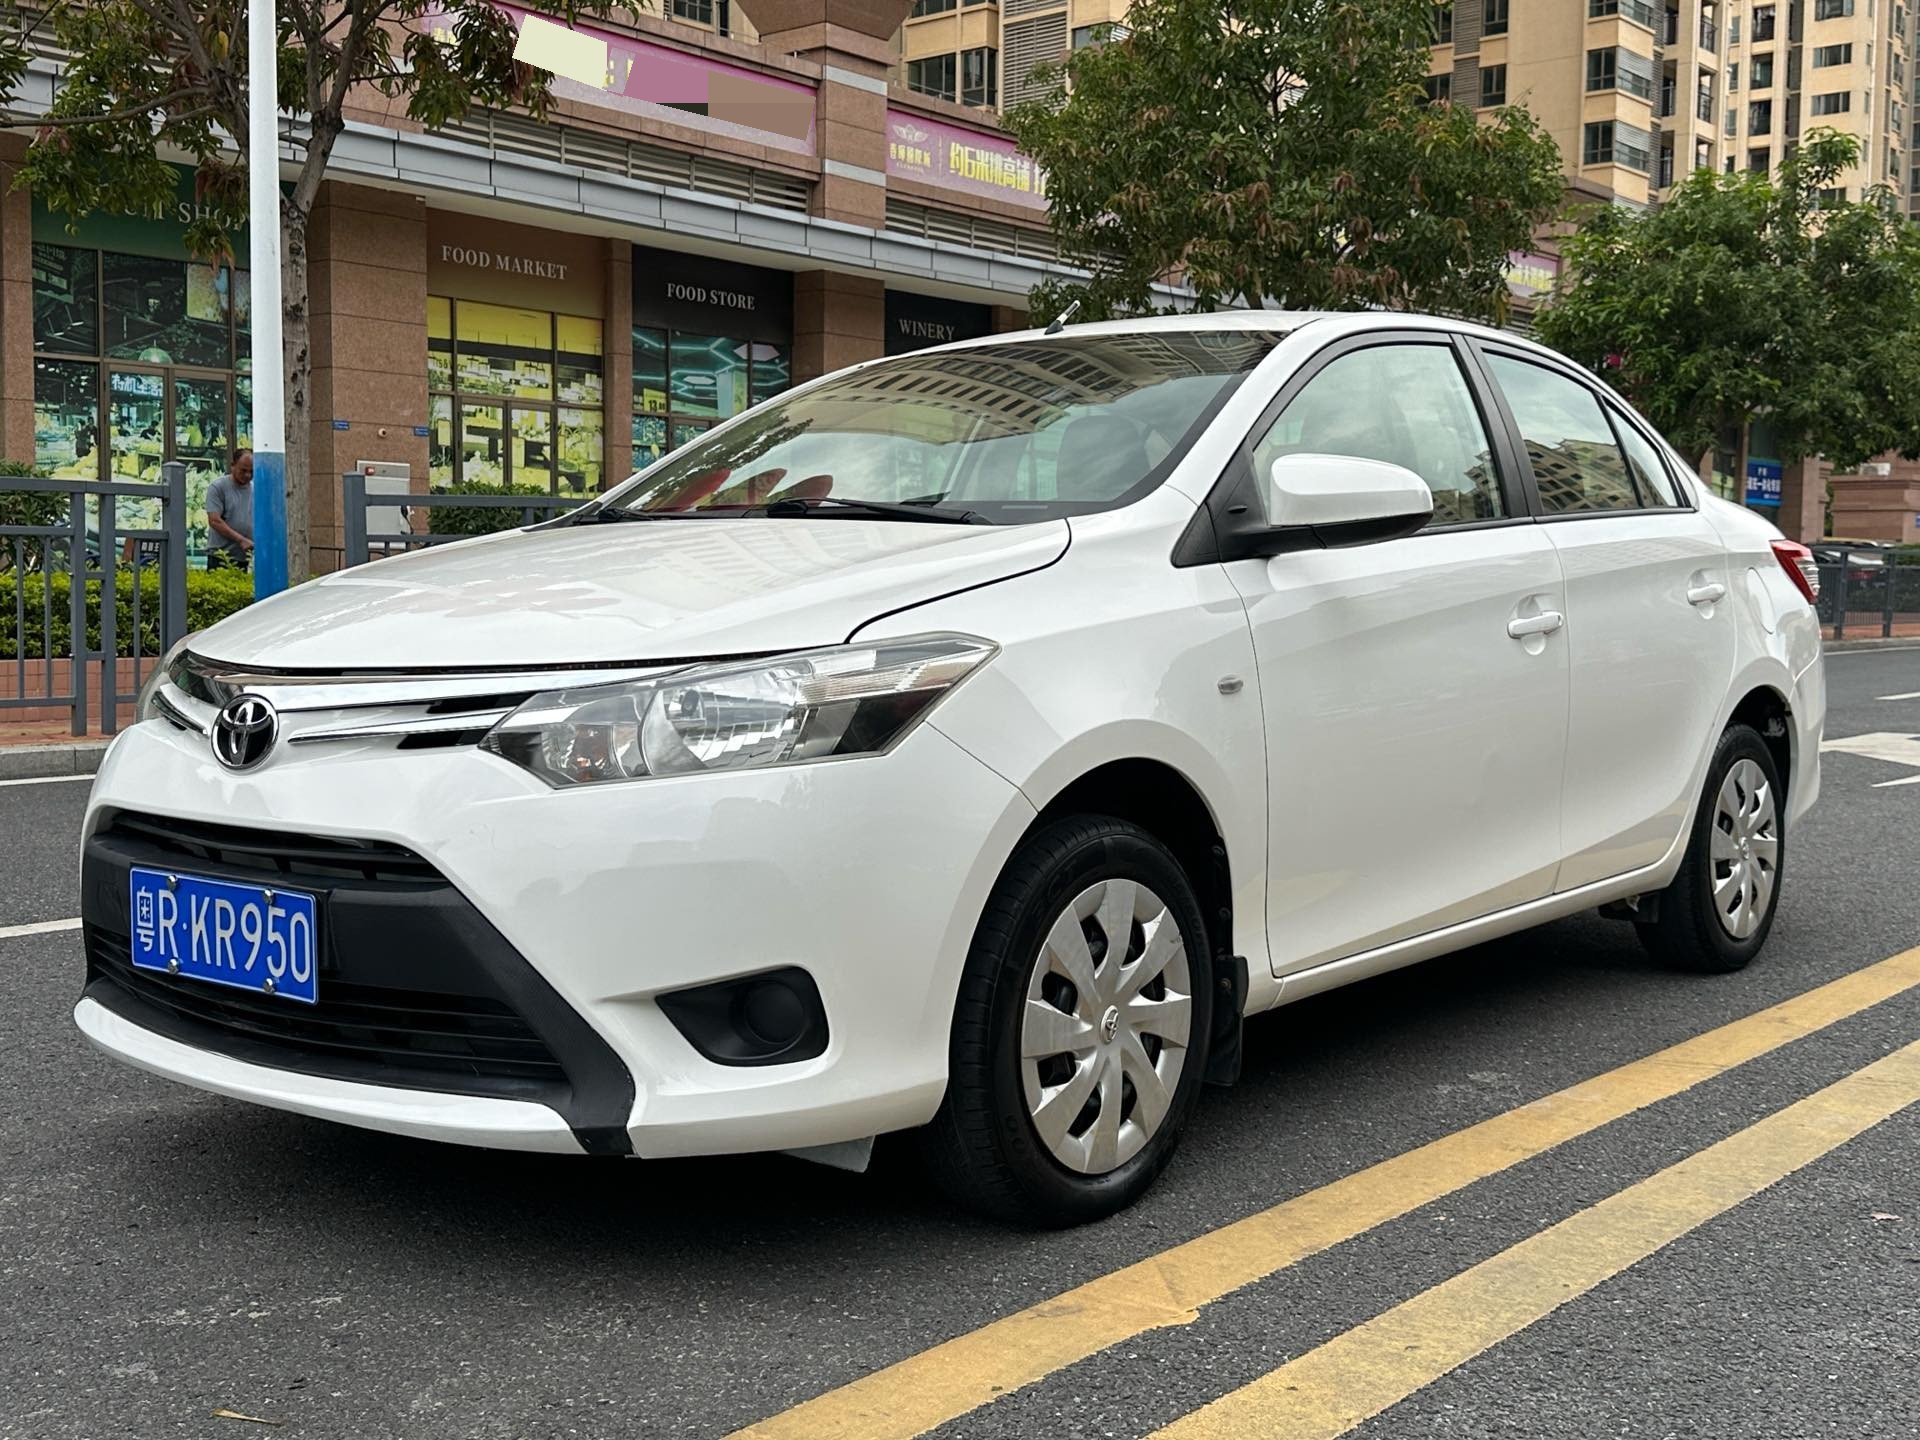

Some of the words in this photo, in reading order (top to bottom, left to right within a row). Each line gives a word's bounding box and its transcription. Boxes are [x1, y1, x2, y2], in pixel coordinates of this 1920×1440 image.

[441, 245, 491, 268] FOOD
[495, 254, 568, 280] MARKET
[667, 282, 707, 303] FOOD
[709, 289, 756, 311] STORE
[898, 319, 956, 341] WINERY
[136, 885, 311, 984] 粤R·KR950
